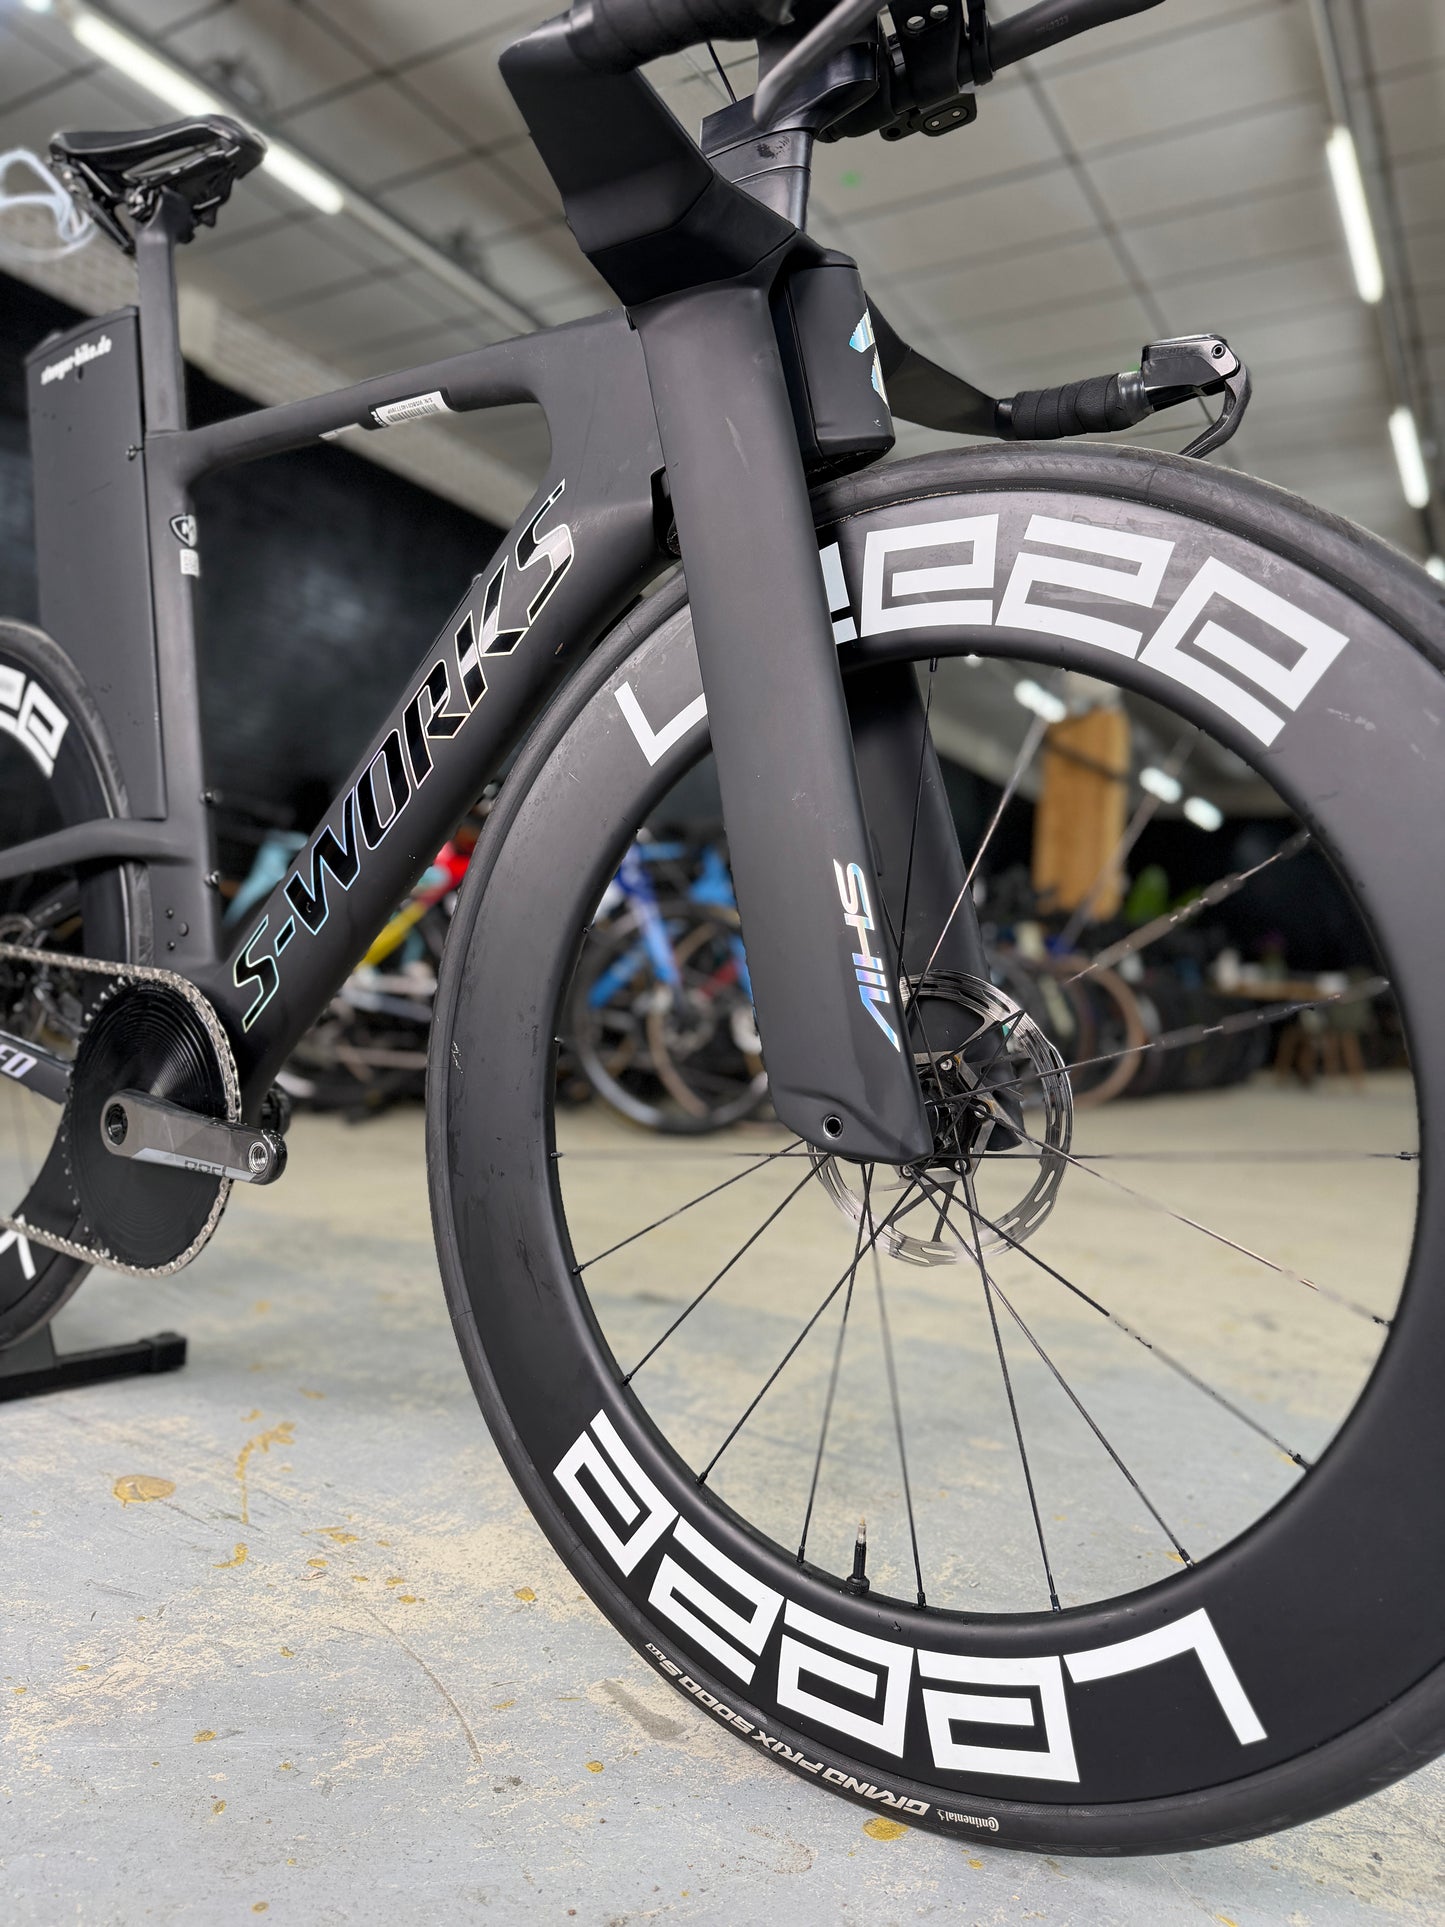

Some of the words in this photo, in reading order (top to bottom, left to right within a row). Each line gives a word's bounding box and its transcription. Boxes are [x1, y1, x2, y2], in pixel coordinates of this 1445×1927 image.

[233, 478, 574, 1034] S-WORKS
[833, 858, 900, 1053] SHIV
[678, 1675, 756, 1734] 5000
[752, 1730, 825, 1774] PRIX
[821, 1766, 931, 1816] GRAND
[944, 1810, 1000, 1832] Continental
